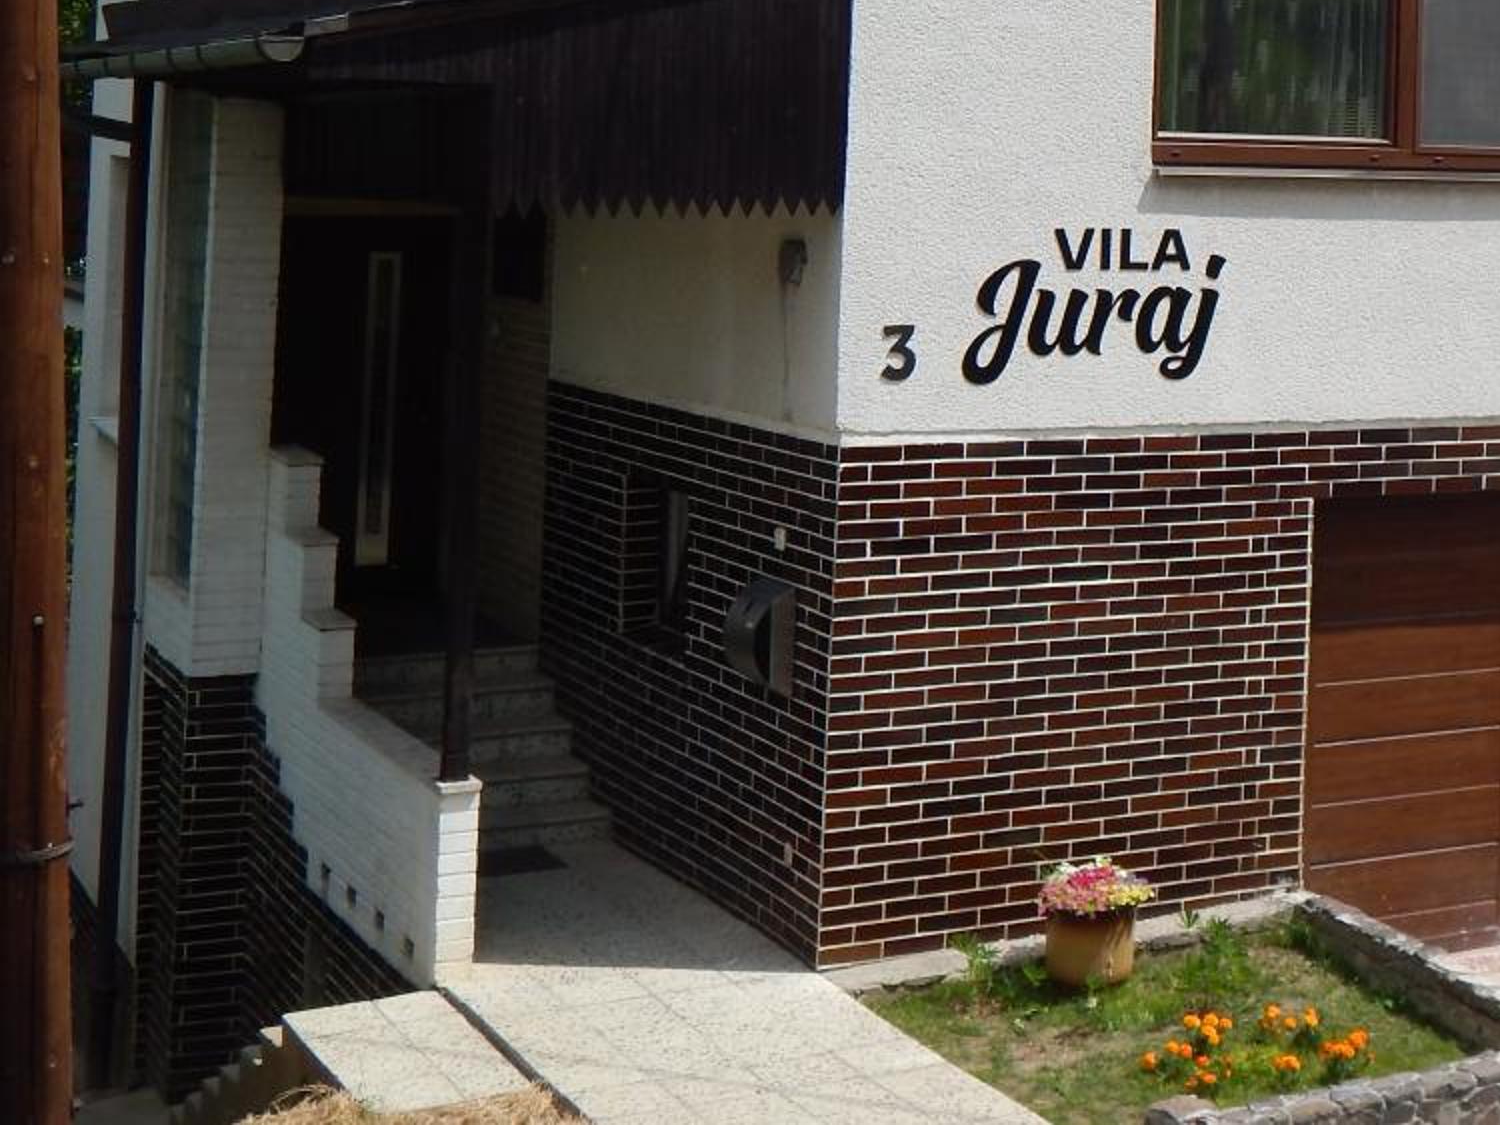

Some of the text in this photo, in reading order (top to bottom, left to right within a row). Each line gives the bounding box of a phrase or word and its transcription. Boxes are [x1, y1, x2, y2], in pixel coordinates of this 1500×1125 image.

[1055, 228, 1191, 271] VILA
[961, 254, 1227, 385] Juraj
[880, 324, 917, 382] 3
